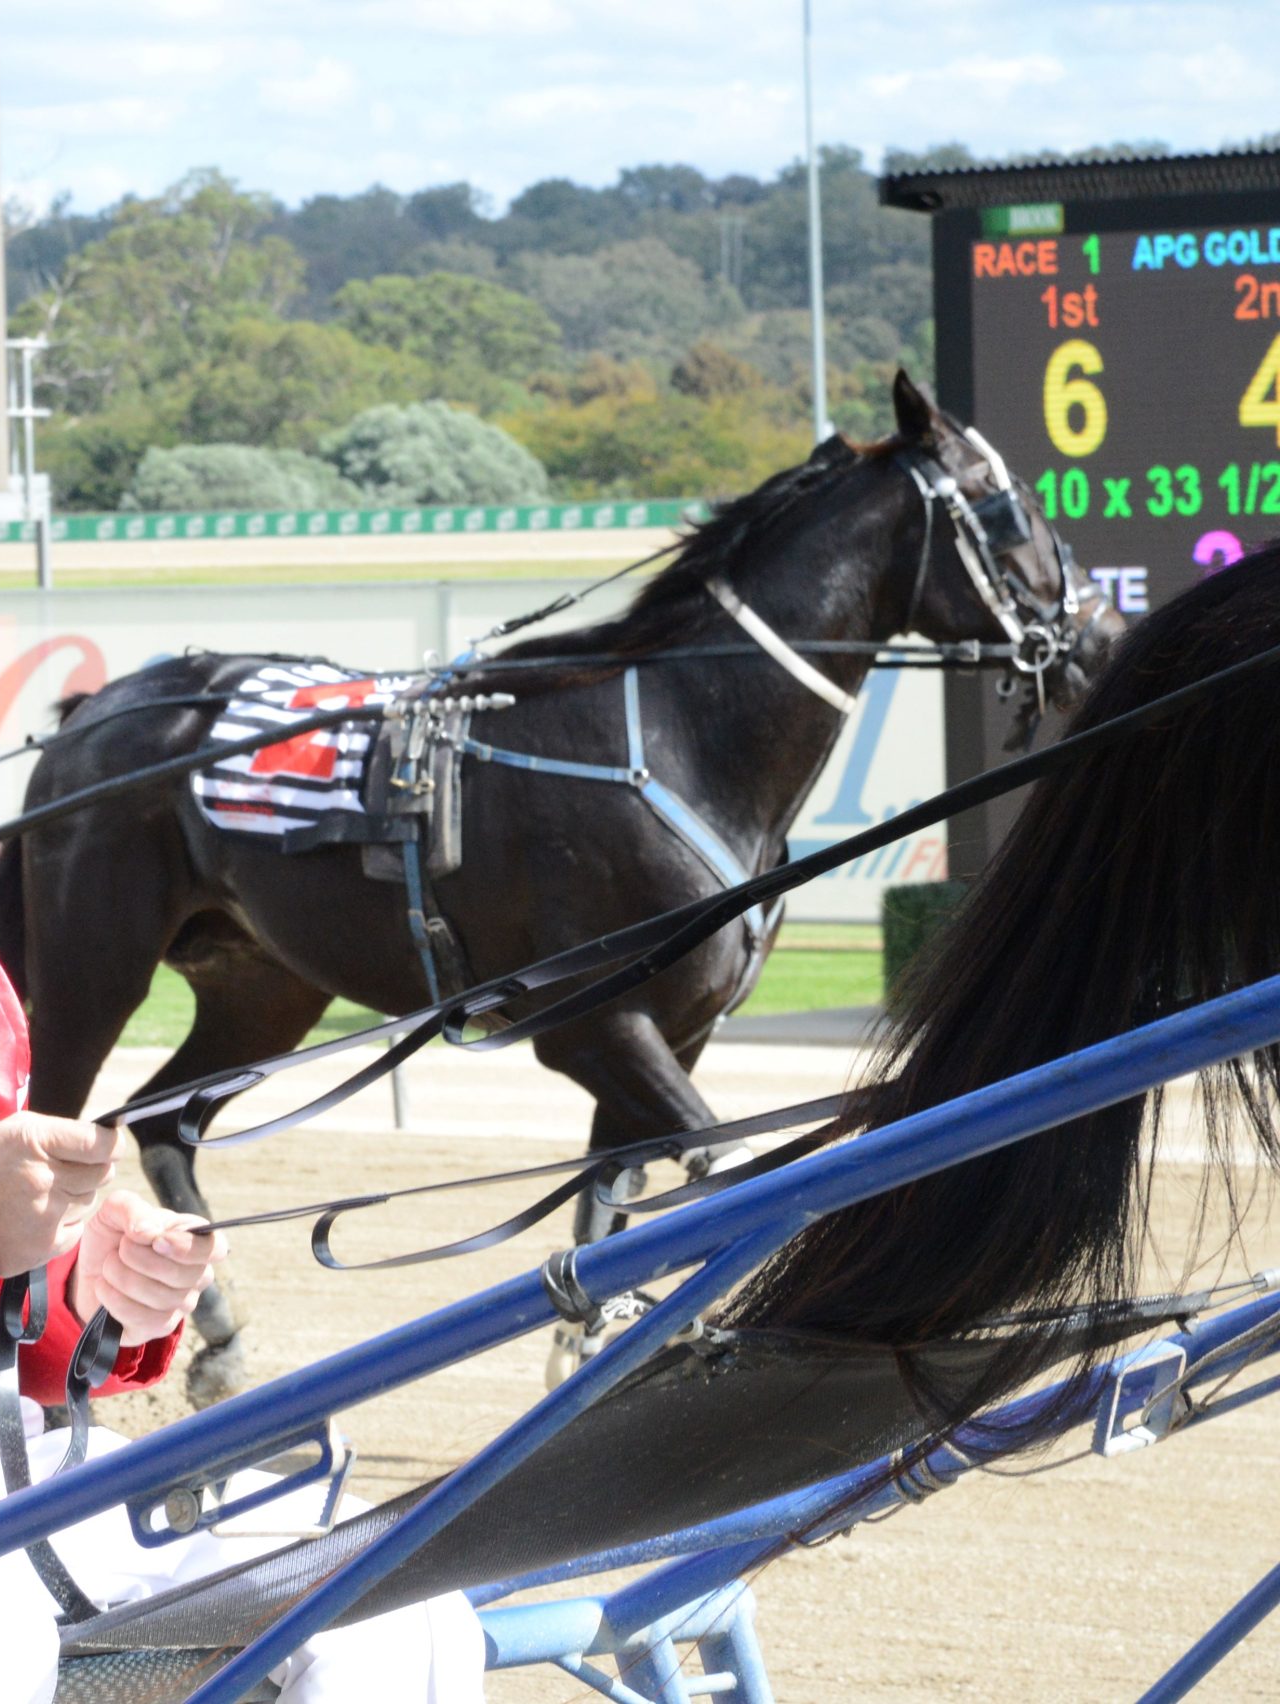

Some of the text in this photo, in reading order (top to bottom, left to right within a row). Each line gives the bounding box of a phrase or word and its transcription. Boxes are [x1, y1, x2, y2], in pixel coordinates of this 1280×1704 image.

[973, 240, 1059, 278] RACE
[1082, 234, 1100, 275] 1
[1132, 233, 1199, 271] APG
[1041, 283, 1100, 328] 1st
[1042, 331, 1280, 457] 6 4
[1035, 460, 1280, 520] 10 x 33 1/2
